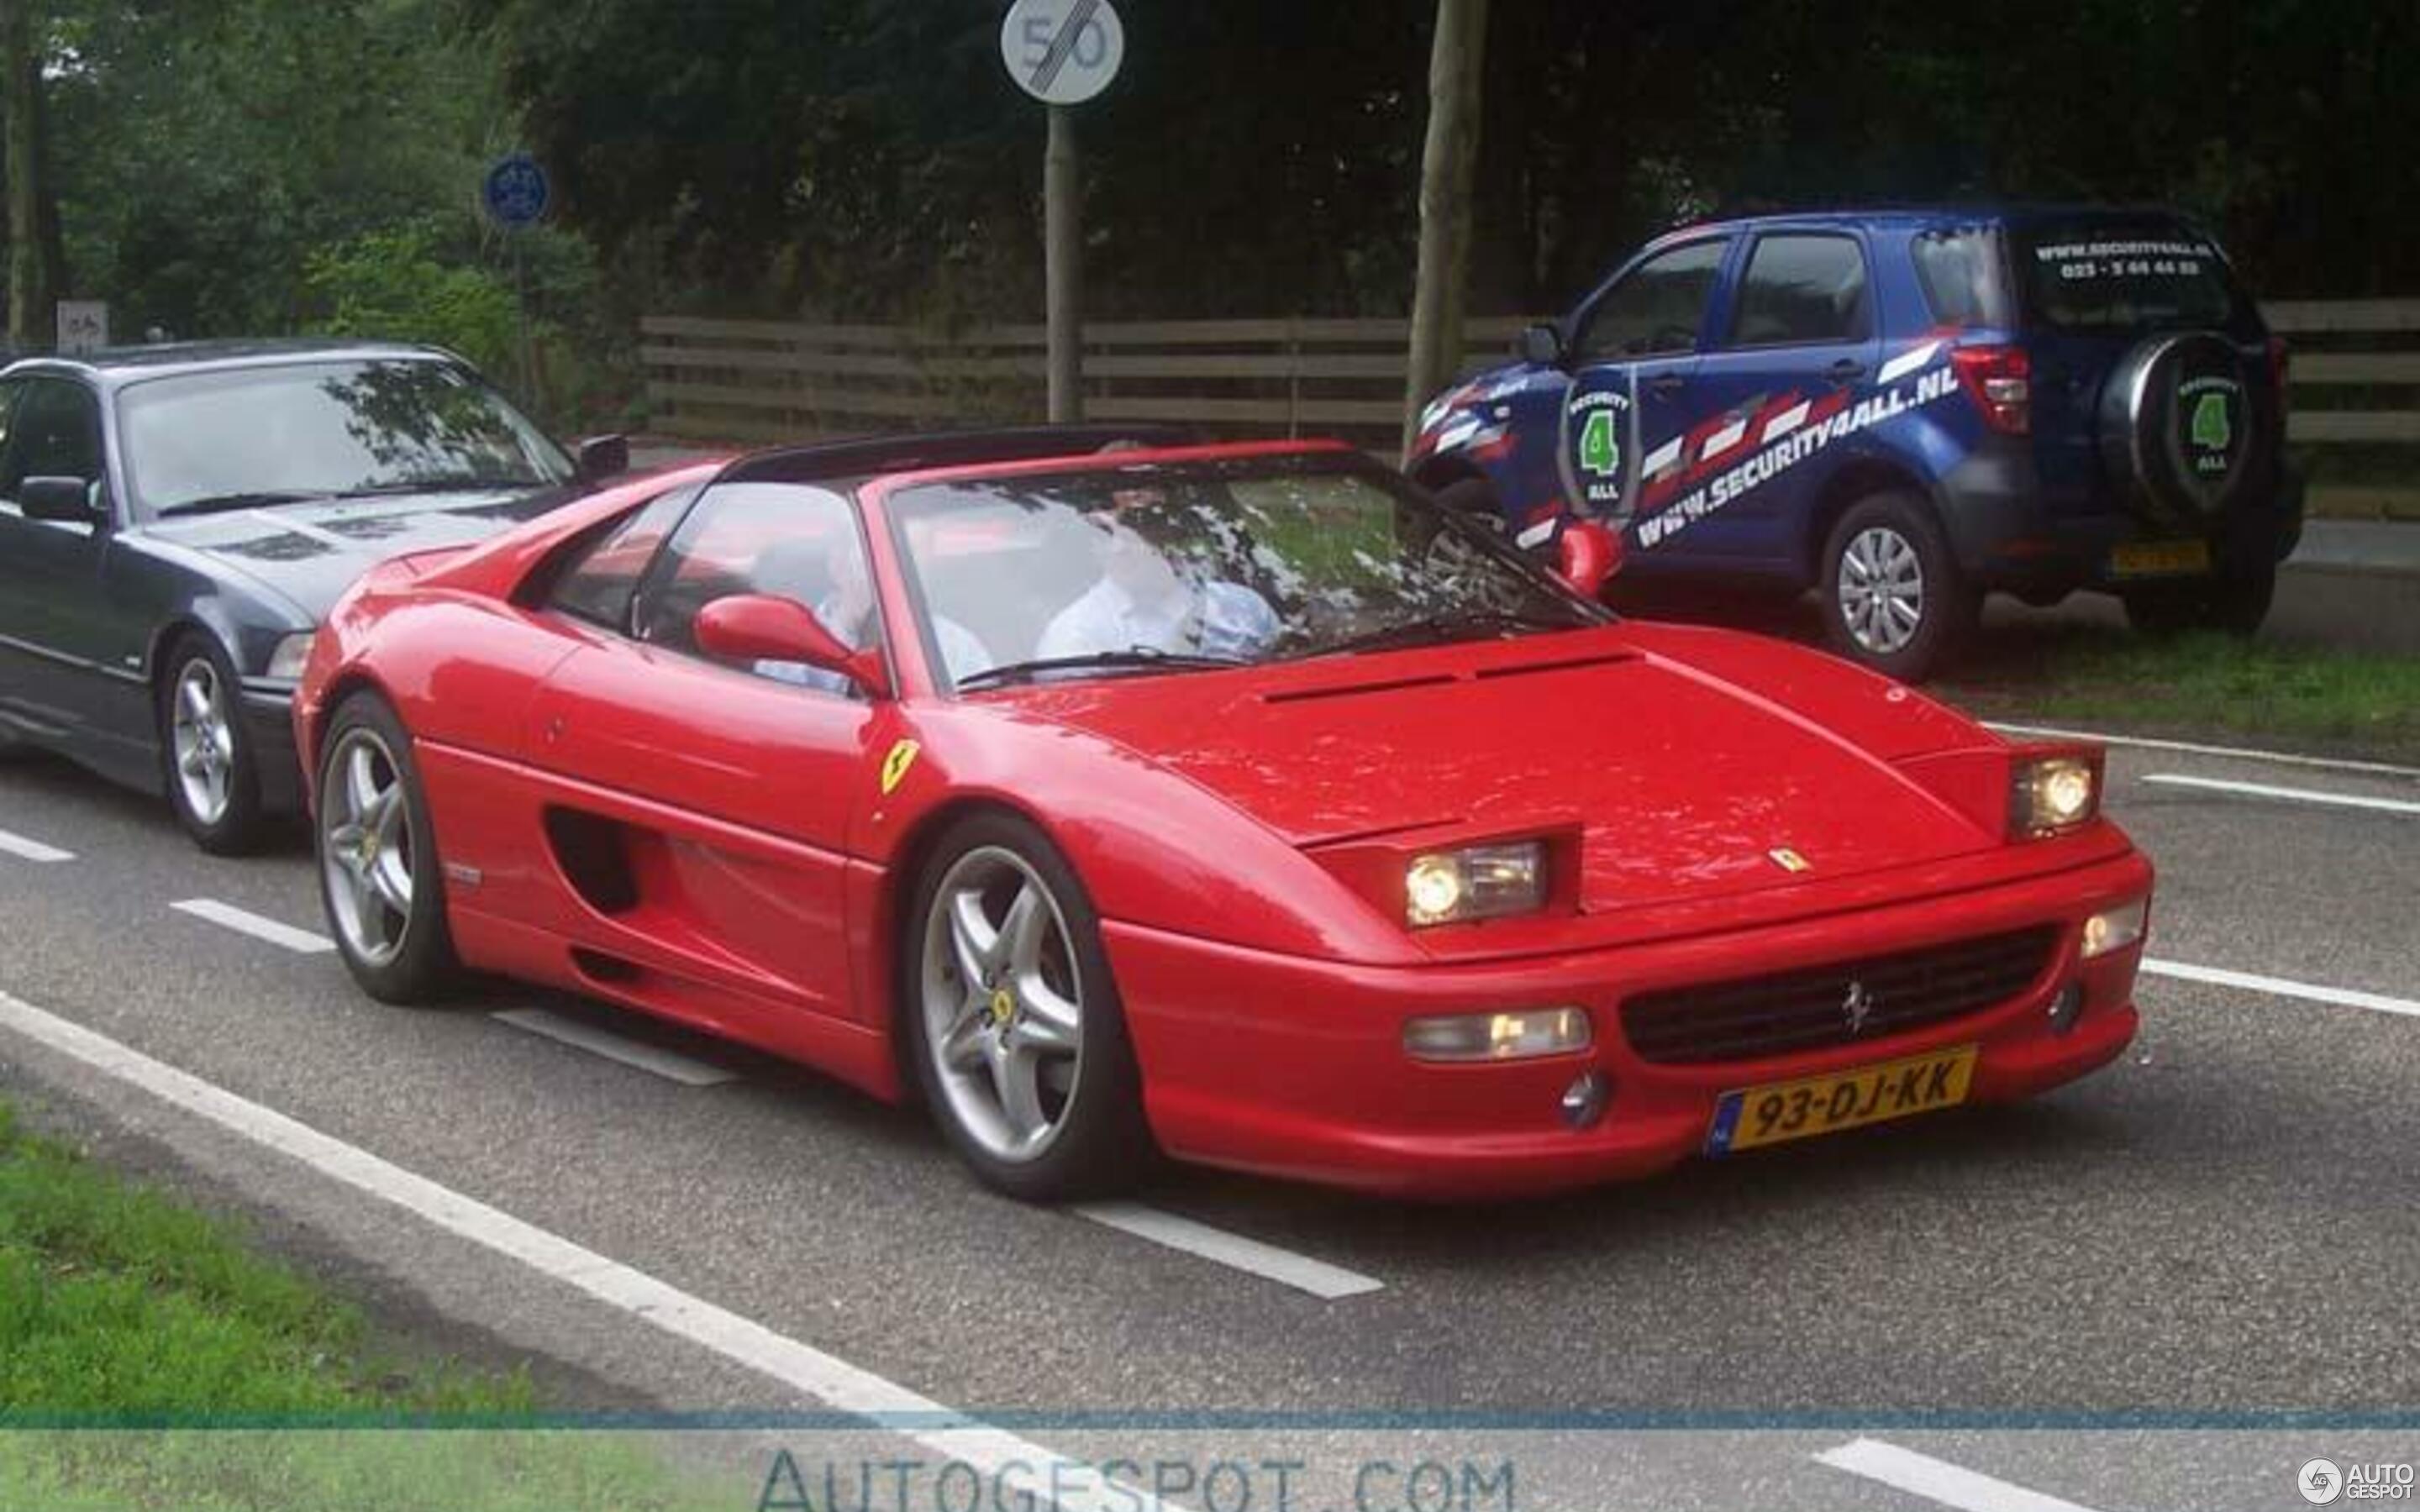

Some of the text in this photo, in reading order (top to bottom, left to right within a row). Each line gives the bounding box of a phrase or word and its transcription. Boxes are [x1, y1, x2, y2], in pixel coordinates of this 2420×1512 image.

[1023, 18, 1107, 69] 50
[1570, 391, 1628, 415] SECURITY
[1581, 410, 1619, 476] 4
[1638, 366, 1959, 549] WWW.SECURITY4ALL.NL
[1588, 483, 1619, 500] ALL
[1756, 1061, 1956, 1137] 93-DJ-KK
